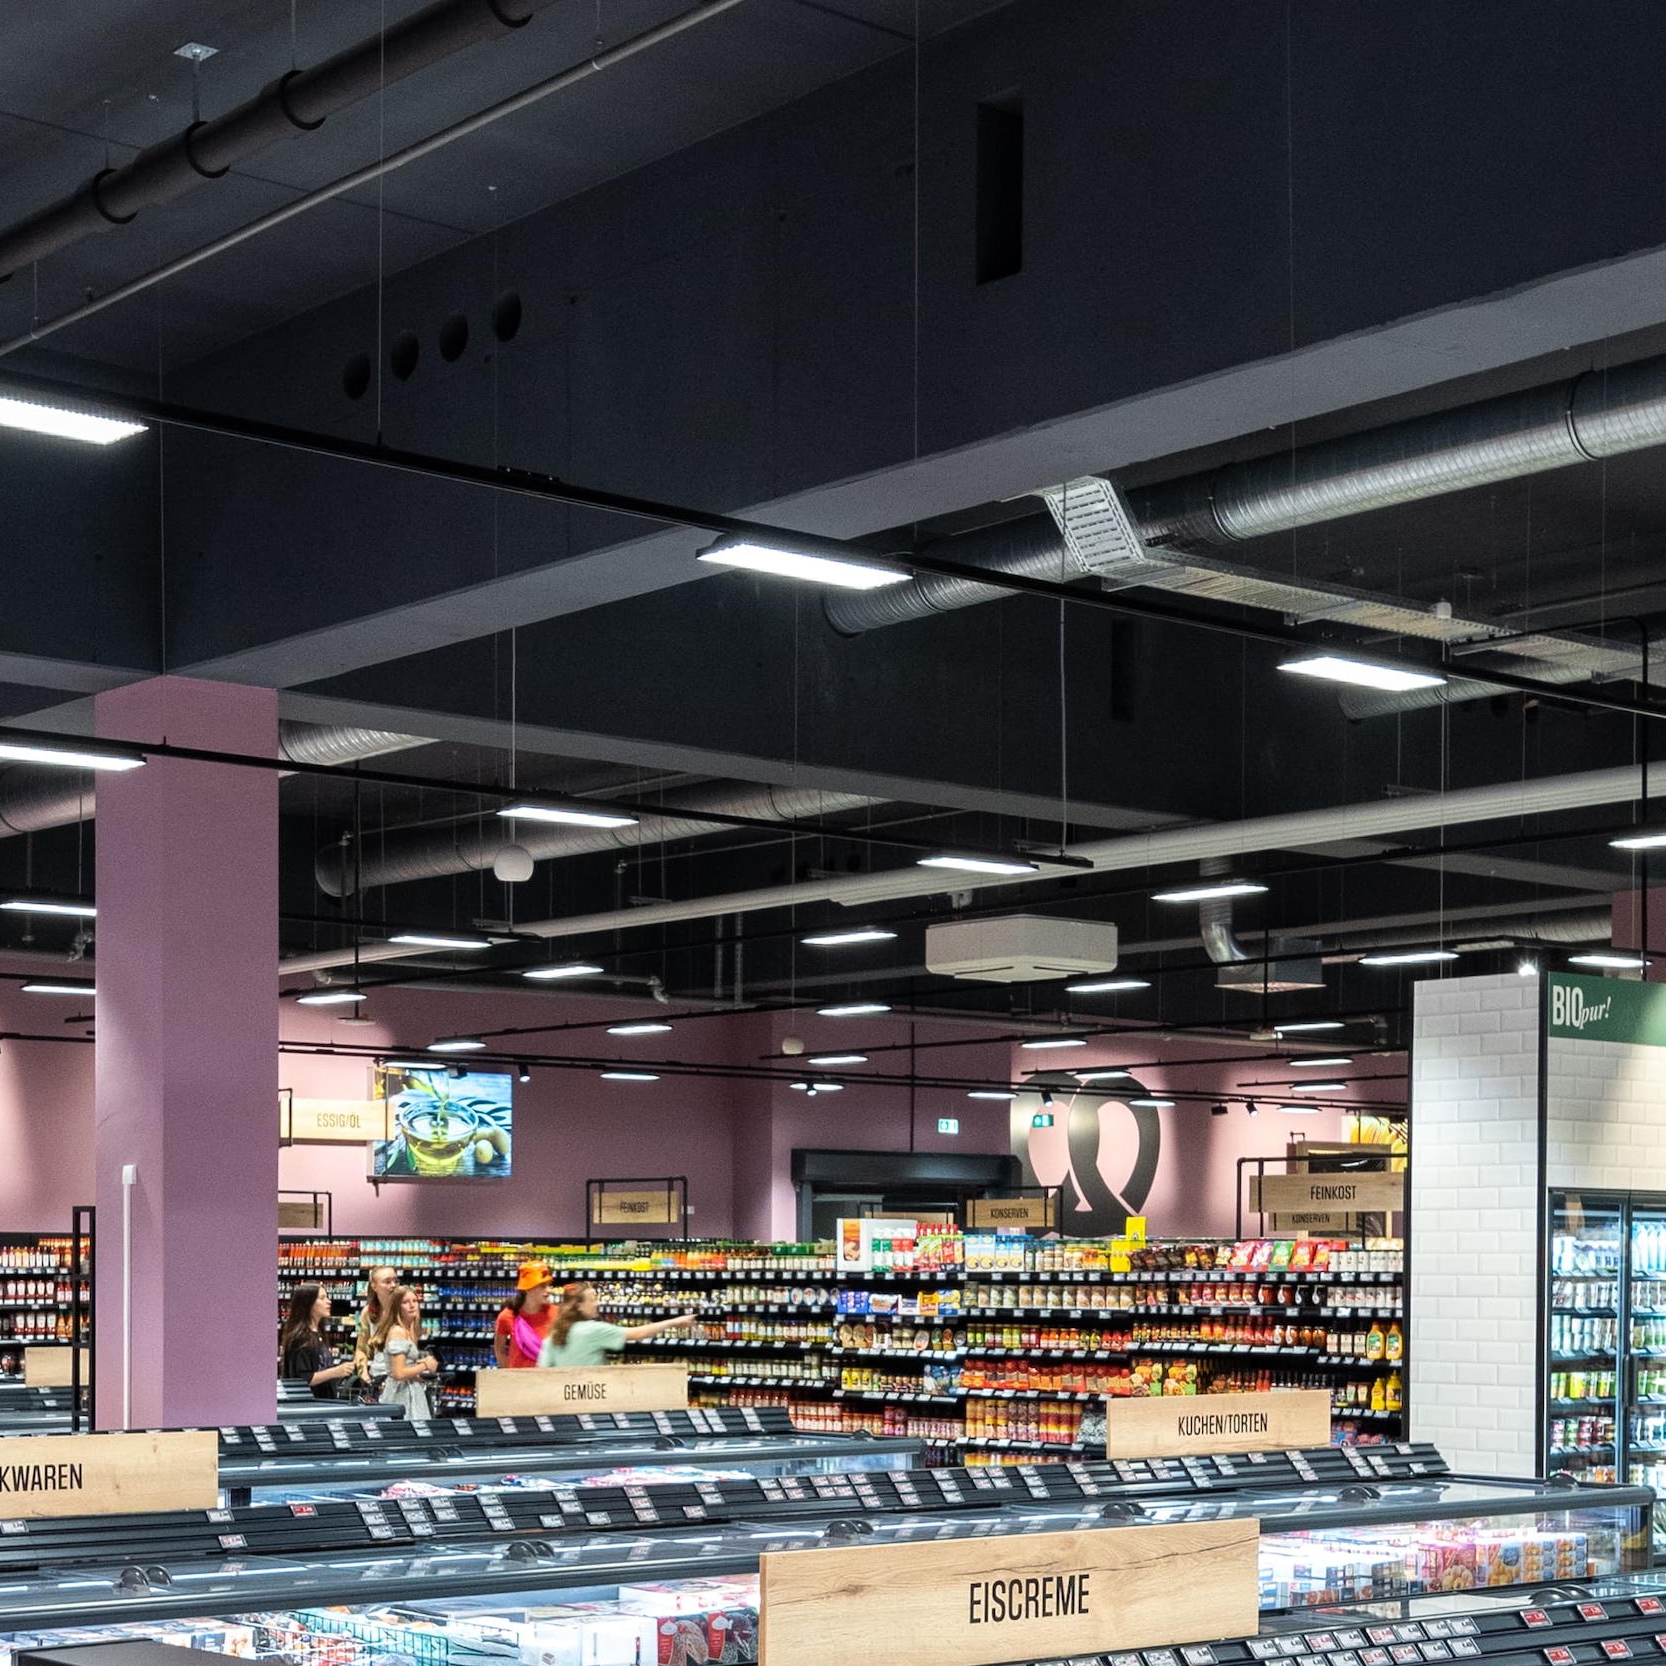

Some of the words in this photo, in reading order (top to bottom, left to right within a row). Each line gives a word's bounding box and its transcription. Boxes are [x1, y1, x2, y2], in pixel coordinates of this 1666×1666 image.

[1310, 1185, 1357, 1201] FEINKOST
[990, 1207, 1030, 1220] KONSERVEN
[1291, 1213, 1331, 1224] KONSERVEN
[563, 1380, 607, 1402] GEMÜSE
[1178, 1412, 1268, 1438] KUCHEN/TORTEN
[969, 1574, 1090, 1624] EISCREME
